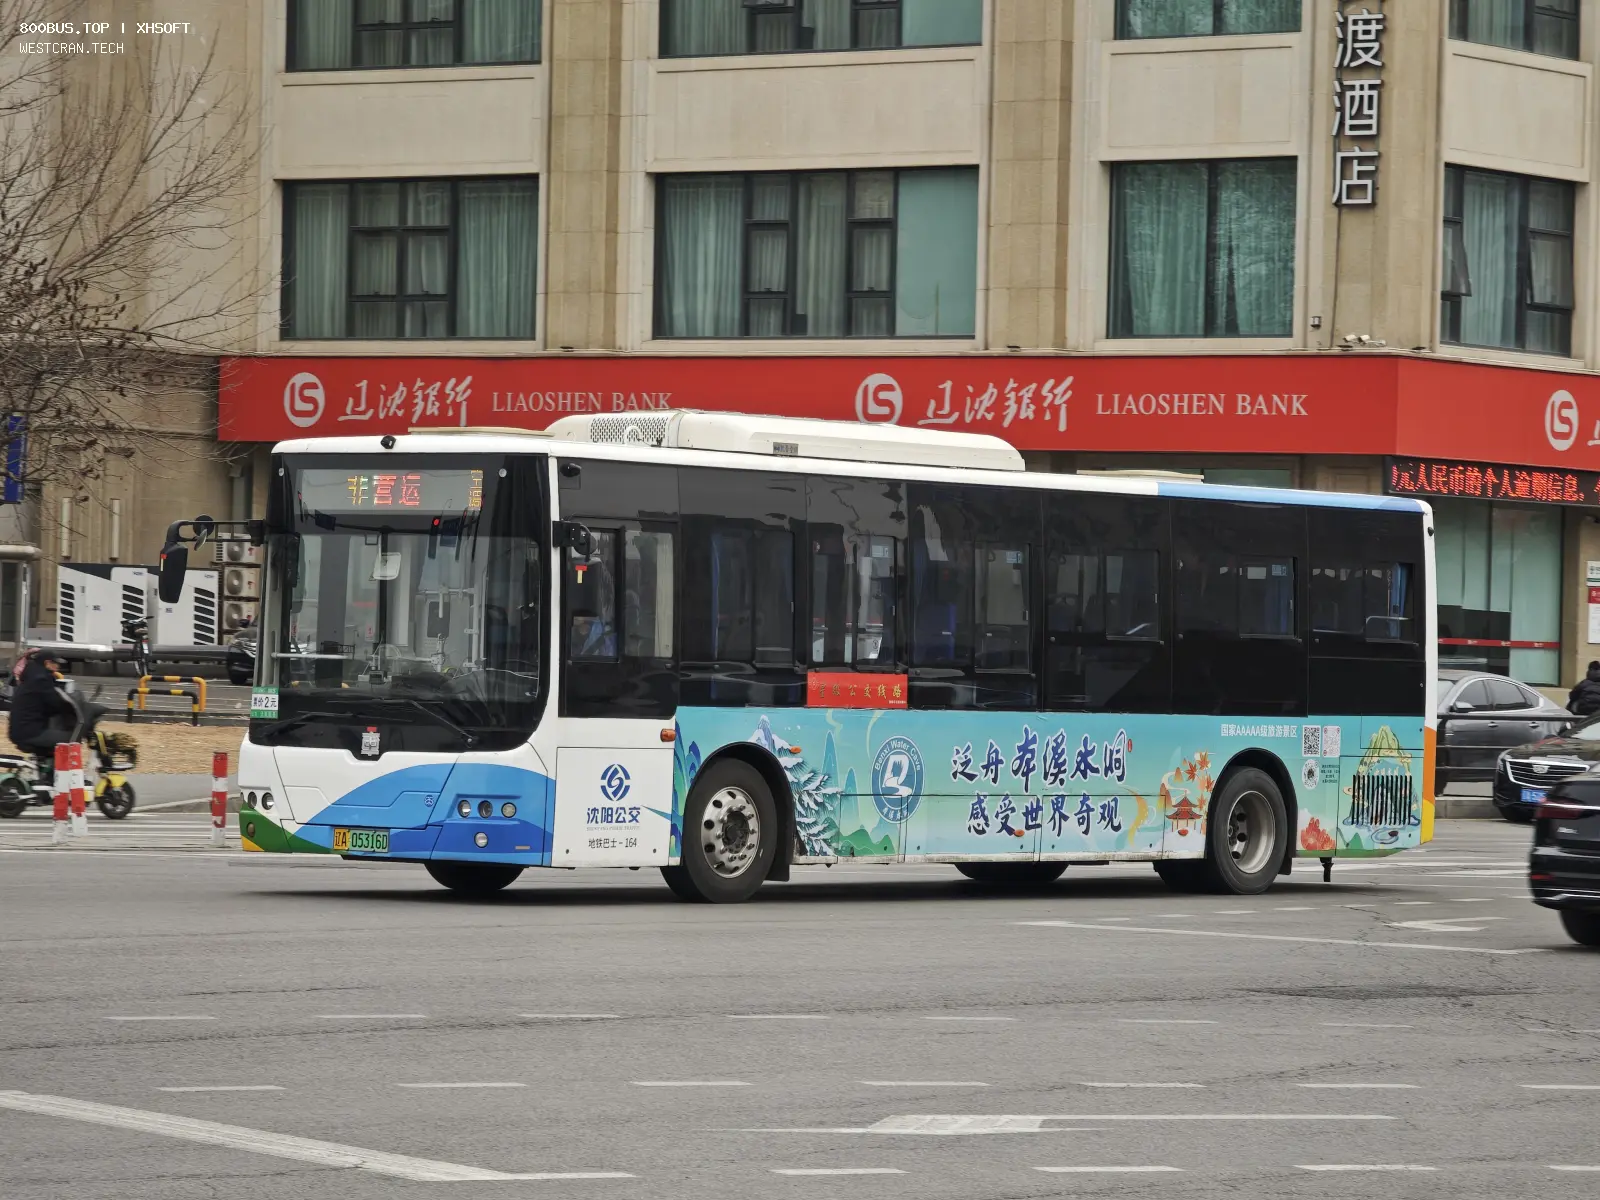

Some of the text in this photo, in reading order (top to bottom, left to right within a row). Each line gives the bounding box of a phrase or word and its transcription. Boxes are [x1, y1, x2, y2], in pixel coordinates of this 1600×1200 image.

[1332, 8, 1384, 205] 渡酒店
[492, 391, 673, 412] LIAOSHEN BANK
[1095, 393, 1308, 416] LIAOSHEN BANK
[347, 475, 421, 506] 非营运
[1221, 724, 1298, 738] 国家AAAAA级旅游景区
[891, 740, 909, 751] Water
[586, 806, 641, 825] 沈阳公交
[966, 792, 1124, 838] 感受世界奇观
[351, 832, 388, 850] 05316D
[625, 837, 637, 848] 164
